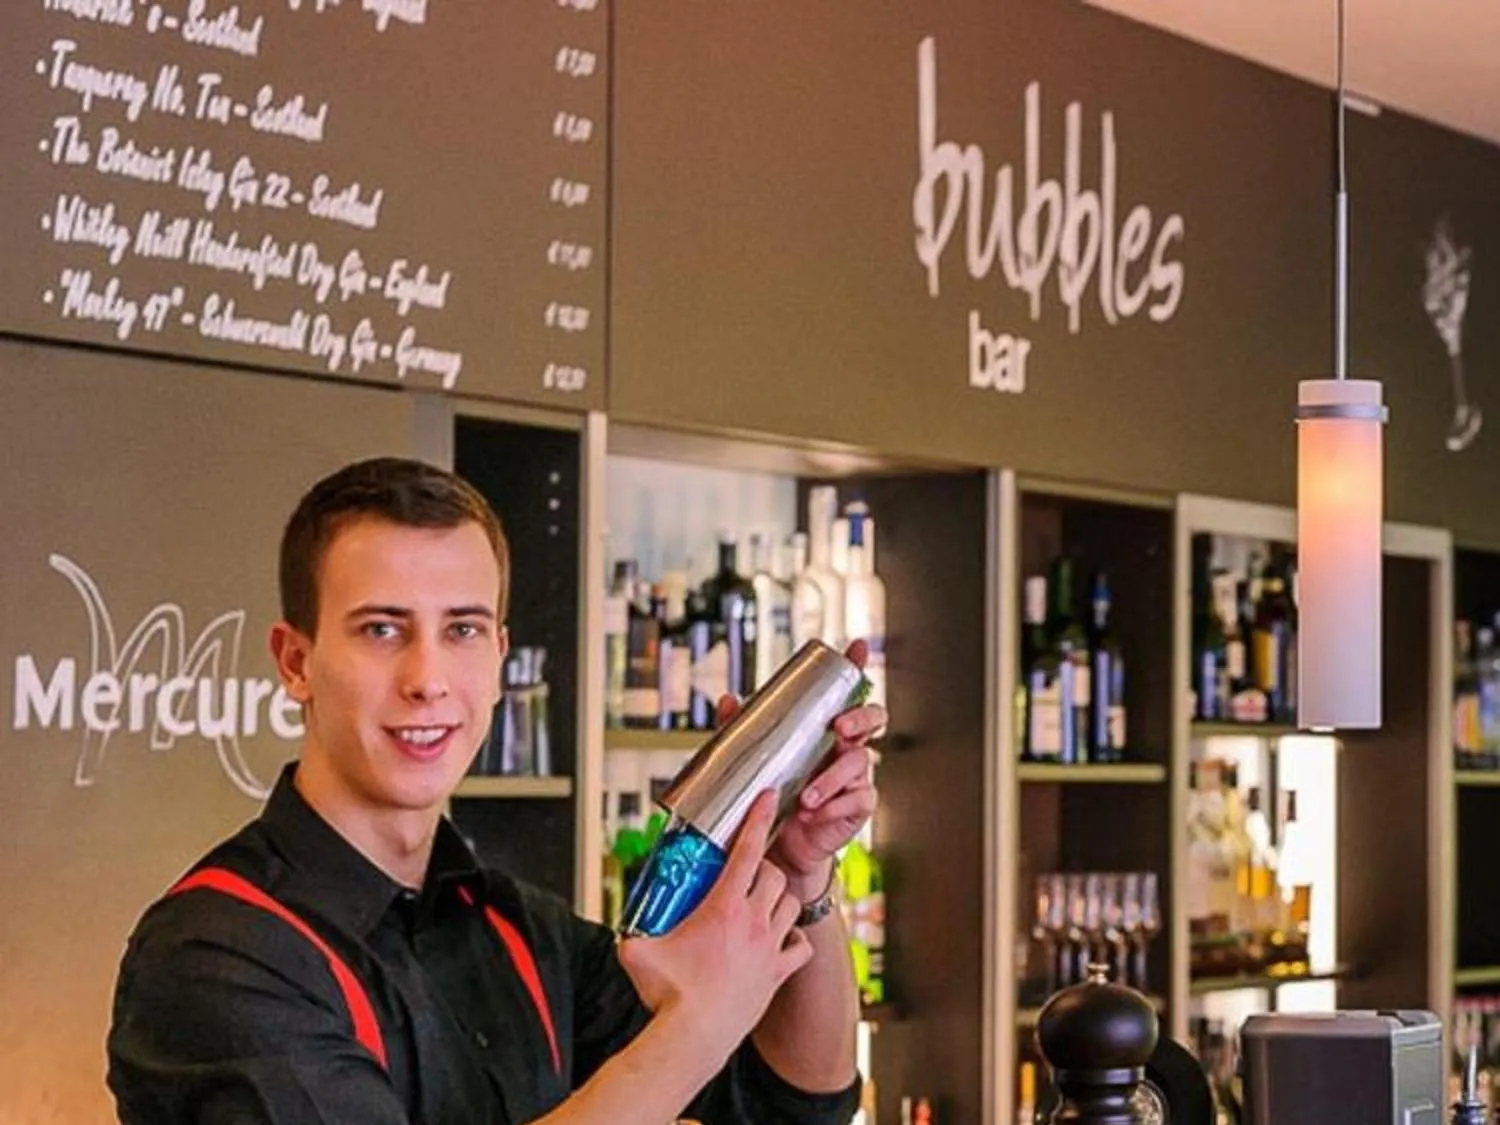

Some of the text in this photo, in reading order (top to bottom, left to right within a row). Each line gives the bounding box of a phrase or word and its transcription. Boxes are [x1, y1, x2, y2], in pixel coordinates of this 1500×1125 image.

[51, 116, 91, 163] The
[262, 172, 290, 208] 22
[913, 36, 1184, 334] bubbles
[968, 310, 1031, 393] bar
[13, 655, 306, 739] Mercure
